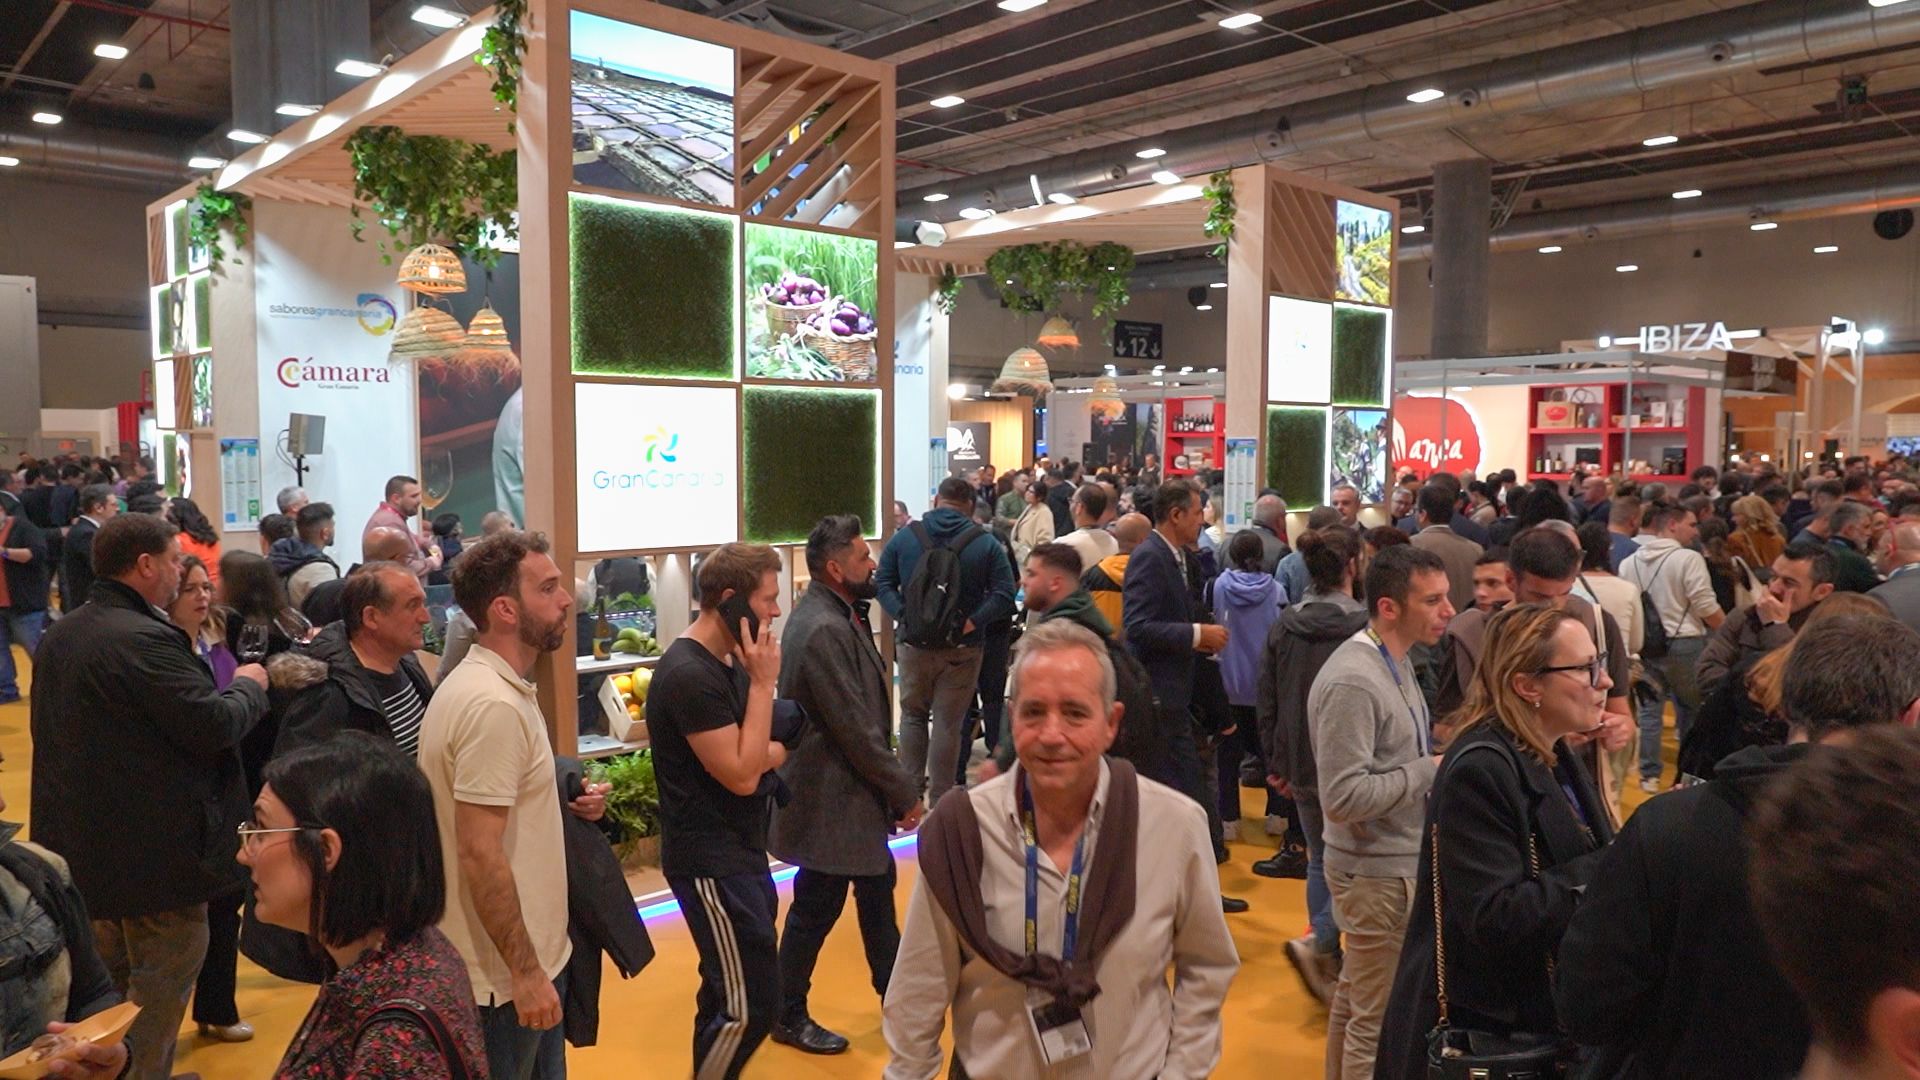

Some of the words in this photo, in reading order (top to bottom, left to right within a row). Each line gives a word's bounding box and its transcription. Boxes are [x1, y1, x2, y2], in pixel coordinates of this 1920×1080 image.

[1130, 337, 1148, 357] 12
[1639, 321, 1734, 353] IBIZA
[277, 357, 391, 388] Cámara
